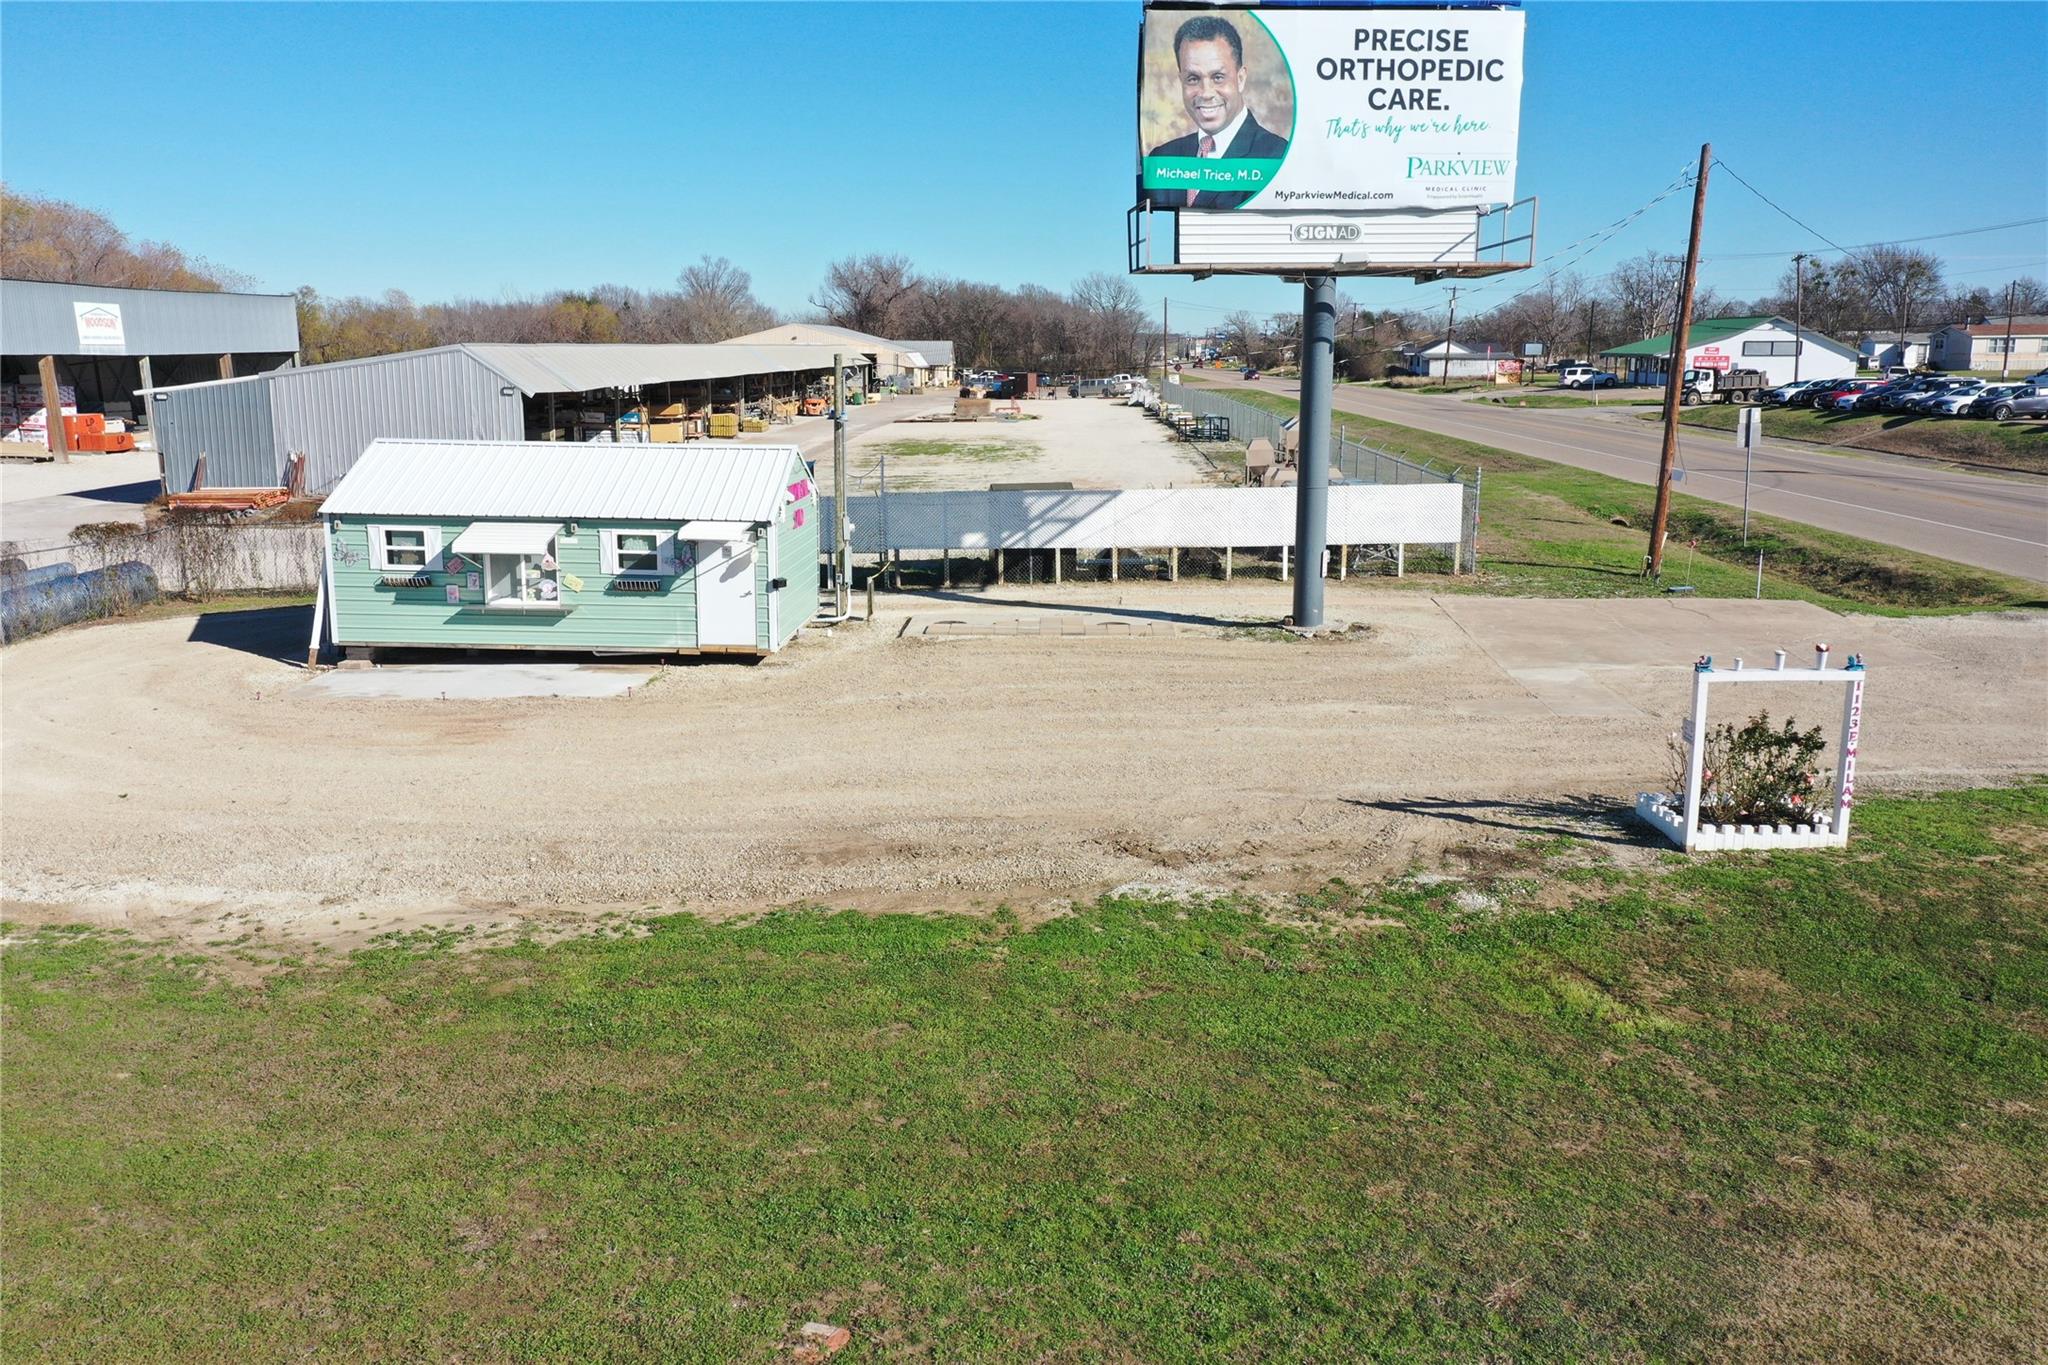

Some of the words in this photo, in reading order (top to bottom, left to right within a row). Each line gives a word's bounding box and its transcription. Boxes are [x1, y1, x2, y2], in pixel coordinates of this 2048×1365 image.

[1354, 28, 1469, 52] PRECISE
[1316, 57, 1504, 82] ORTHOPEDIC
[1368, 87, 1450, 111] CARE.
[1326, 116, 1369, 139] That's
[1375, 115, 1404, 144] why
[1410, 118, 1450, 133] we're
[1156, 167, 1201, 180] Michael
[1203, 169, 1234, 182] Trice,
[1237, 170, 1264, 181] M.D.
[1274, 190, 1394, 202] MyParkviewMedical.com
